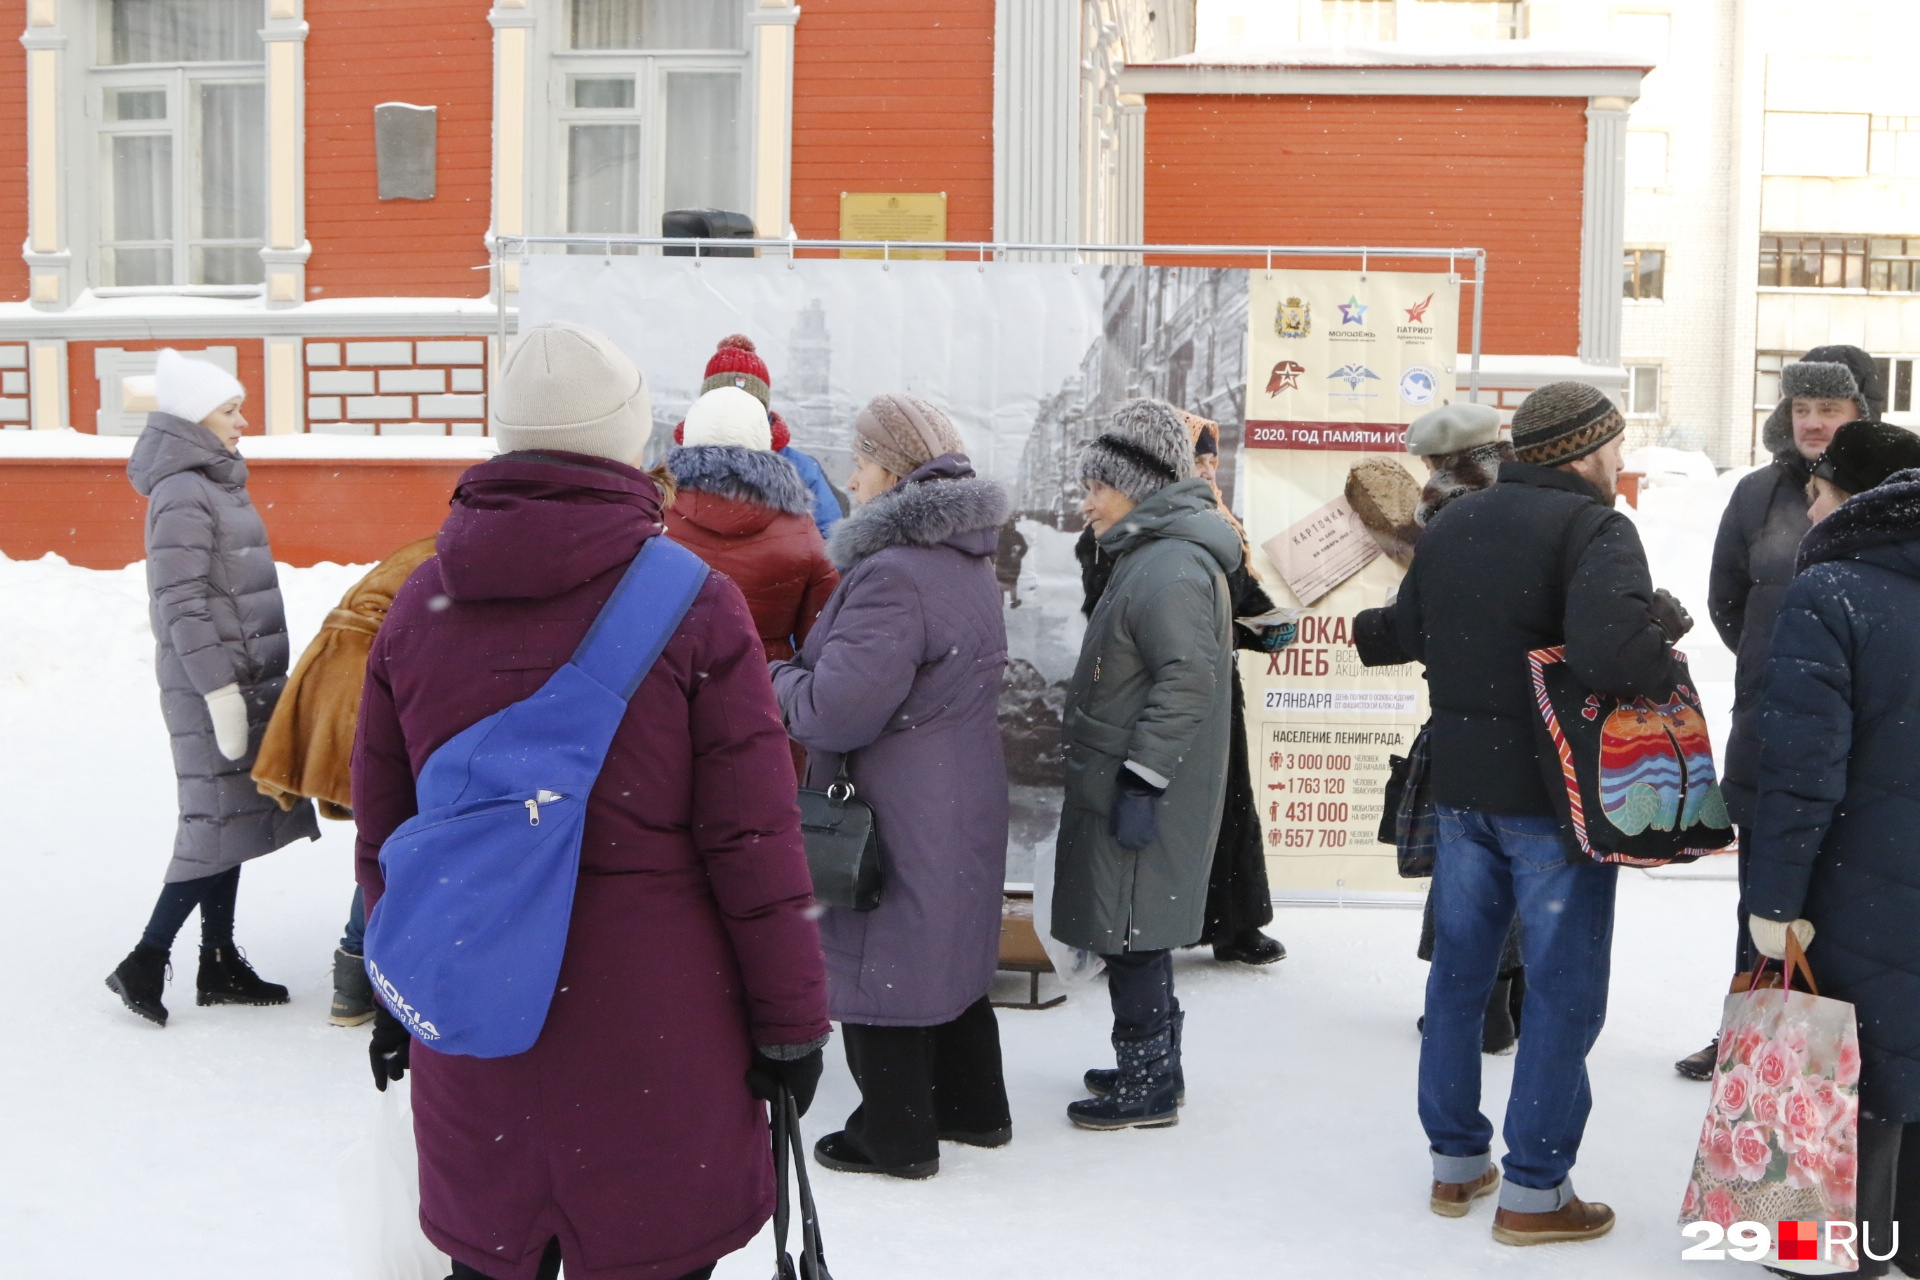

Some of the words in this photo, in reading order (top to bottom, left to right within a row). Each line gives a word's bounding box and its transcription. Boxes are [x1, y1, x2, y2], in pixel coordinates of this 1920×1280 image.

[1397, 326, 1433, 334] ПАТРИОТ
[1254, 429, 1288, 441] 2020.
[1292, 430, 1319, 444] ГОД
[1323, 430, 1381, 443] ПАМЯТИ
[1385, 432, 1395, 443] И
[1292, 509, 1345, 545] КАРТОЧКА
[1266, 648, 1329, 676] ХЛЕБ
[1335, 664, 1368, 677] АКЦИЯ
[1273, 730, 1332, 744] НАСЕЛЕНИЕ
[1334, 732, 1404, 746] ЛЕНИНГРАДА:
[1286, 753, 1295, 770] 3
[1298, 754, 1323, 770] 000
[1326, 754, 1352, 771] 000
[1288, 778, 1293, 794] 1
[1297, 778, 1320, 794] 763
[1324, 778, 1345, 794] 120
[1285, 802, 1313, 822] 431
[1317, 802, 1348, 823] 000
[1284, 829, 1314, 848] 557
[1318, 829, 1347, 848] 700
[369, 960, 441, 1036] NOKIA
